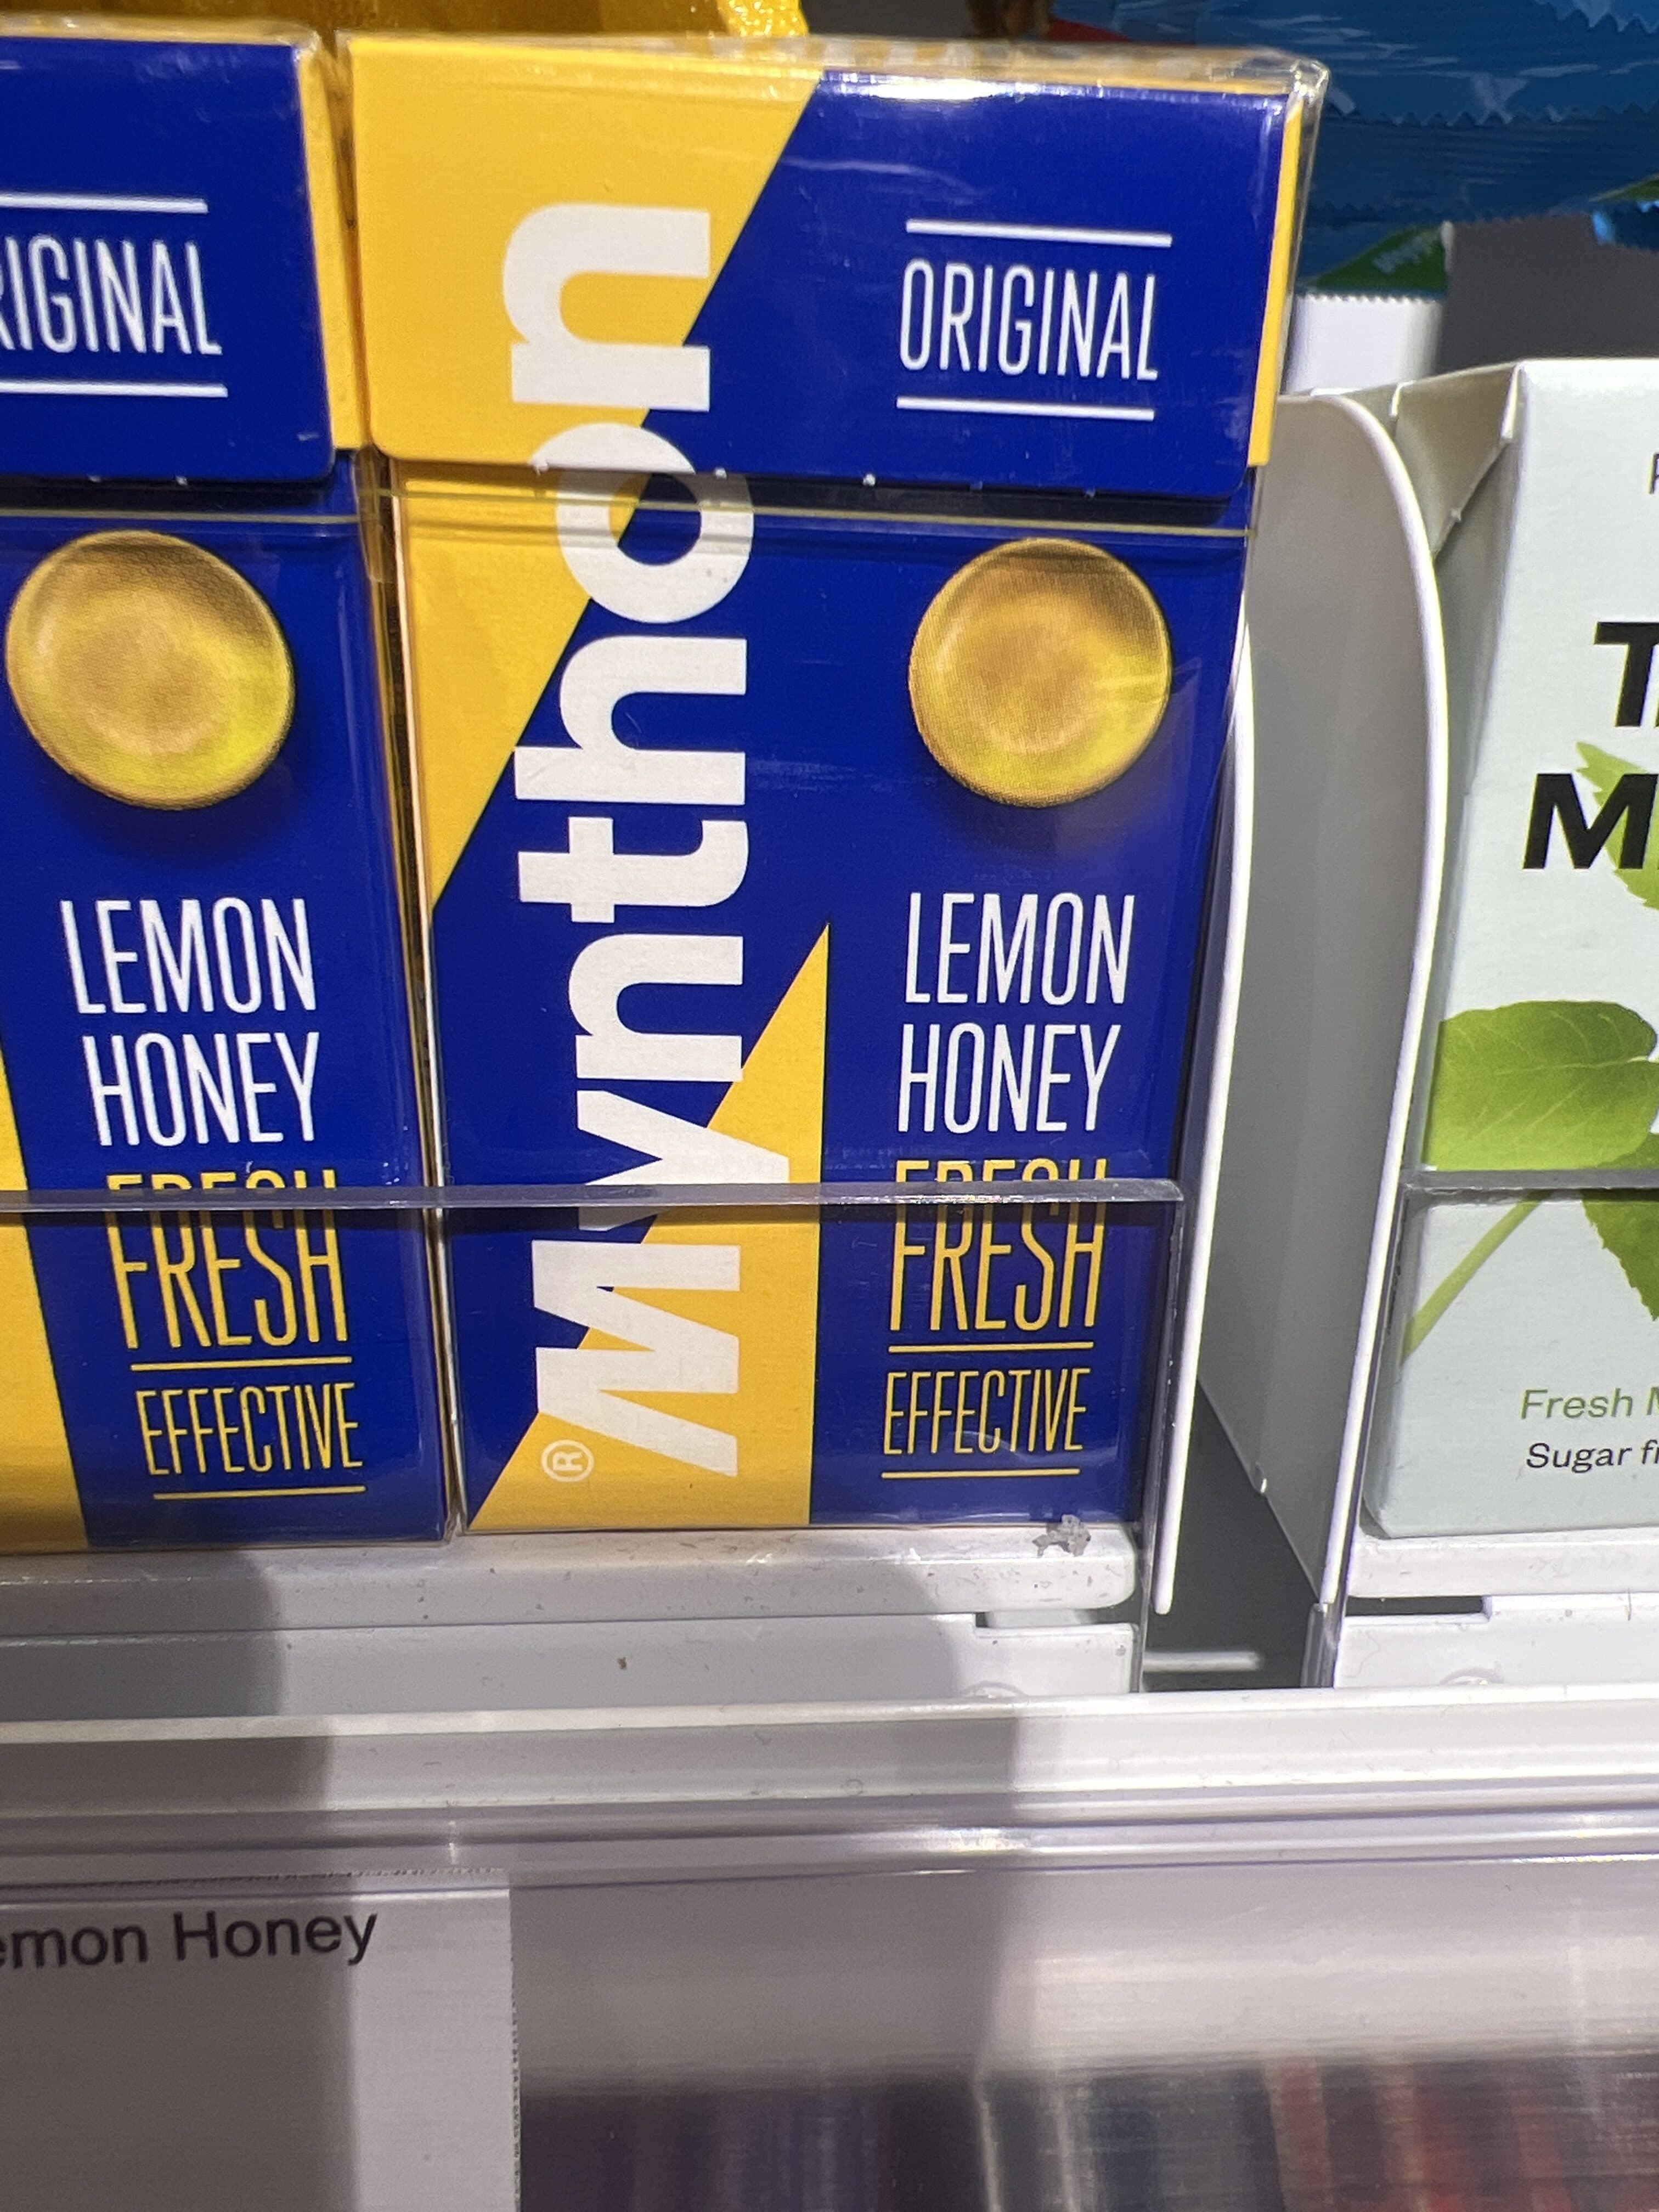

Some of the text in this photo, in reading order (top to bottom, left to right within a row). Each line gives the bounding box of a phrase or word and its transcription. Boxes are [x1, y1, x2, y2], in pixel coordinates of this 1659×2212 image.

[899, 258, 1158, 380] ORIGINAL
[1593, 622, 1659, 727] T
[502, 202, 790, 1477] Mynthon
[1522, 774, 1659, 869] M
[60, 897, 316, 1014] LEMON
[905, 892, 1135, 1005] LEMON
[82, 1031, 319, 1147] HONEY
[898, 1022, 1121, 1133] HONEY
[106, 1169, 348, 1349] FRESH
[890, 1159, 1107, 1331] FRESH
[136, 1382, 363, 1475] EFFECTIVE
[883, 1368, 1091, 1455] EFFECTIVE
[1520, 1387, 1633, 1420] Fresh
[1526, 1442, 1633, 1474] Sugar
[0, 1910, 378, 1969] mon Honey
